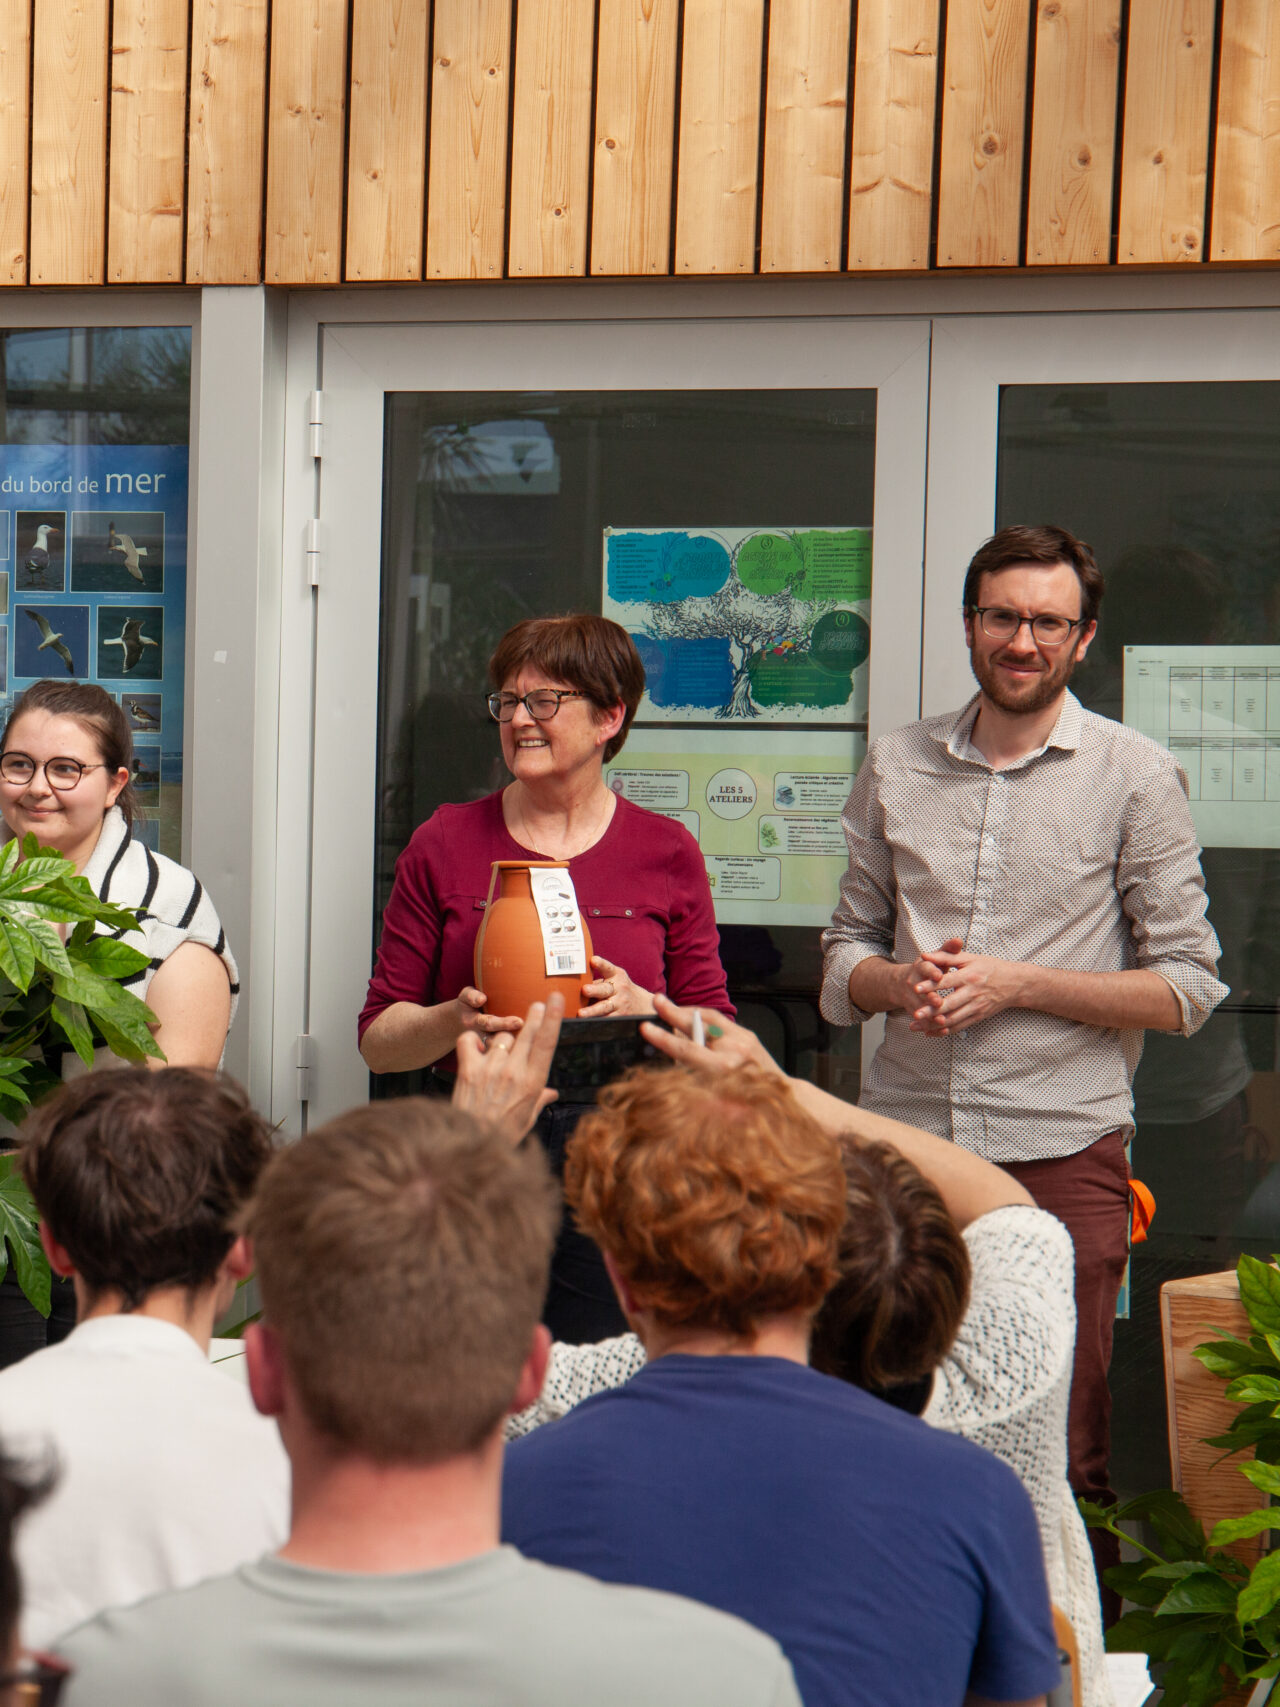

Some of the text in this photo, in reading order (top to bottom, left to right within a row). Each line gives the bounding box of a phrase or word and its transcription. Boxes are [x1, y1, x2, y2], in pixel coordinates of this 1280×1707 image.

[1, 476, 24, 493] du
[29, 476, 72, 493] bord
[78, 476, 99, 493] de
[105, 472, 167, 494] mer
[719, 785, 744, 794] LES 5
[709, 795, 753, 803] ATELIERS
